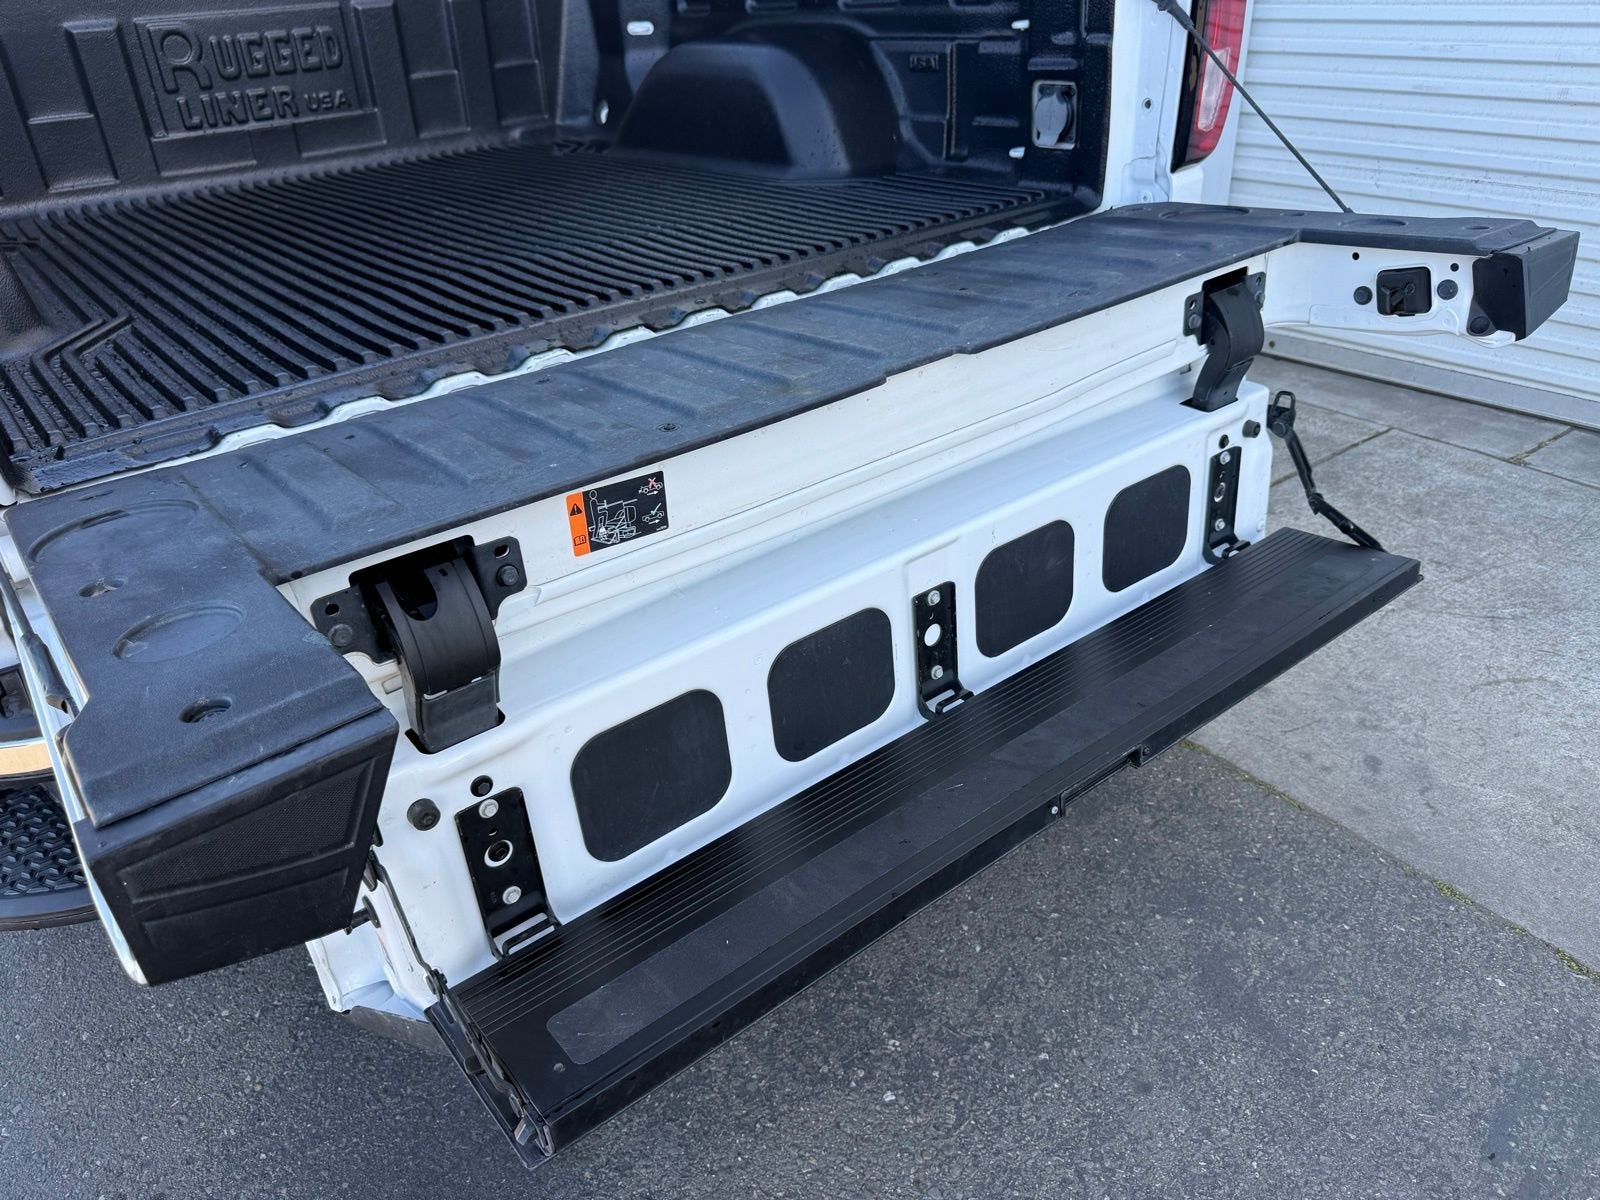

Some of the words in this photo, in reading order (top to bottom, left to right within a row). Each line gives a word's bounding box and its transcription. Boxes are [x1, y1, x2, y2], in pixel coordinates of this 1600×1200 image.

[146, 24, 343, 93] RUGGED
[176, 86, 299, 130] LINER
[304, 90, 349, 112] USA
